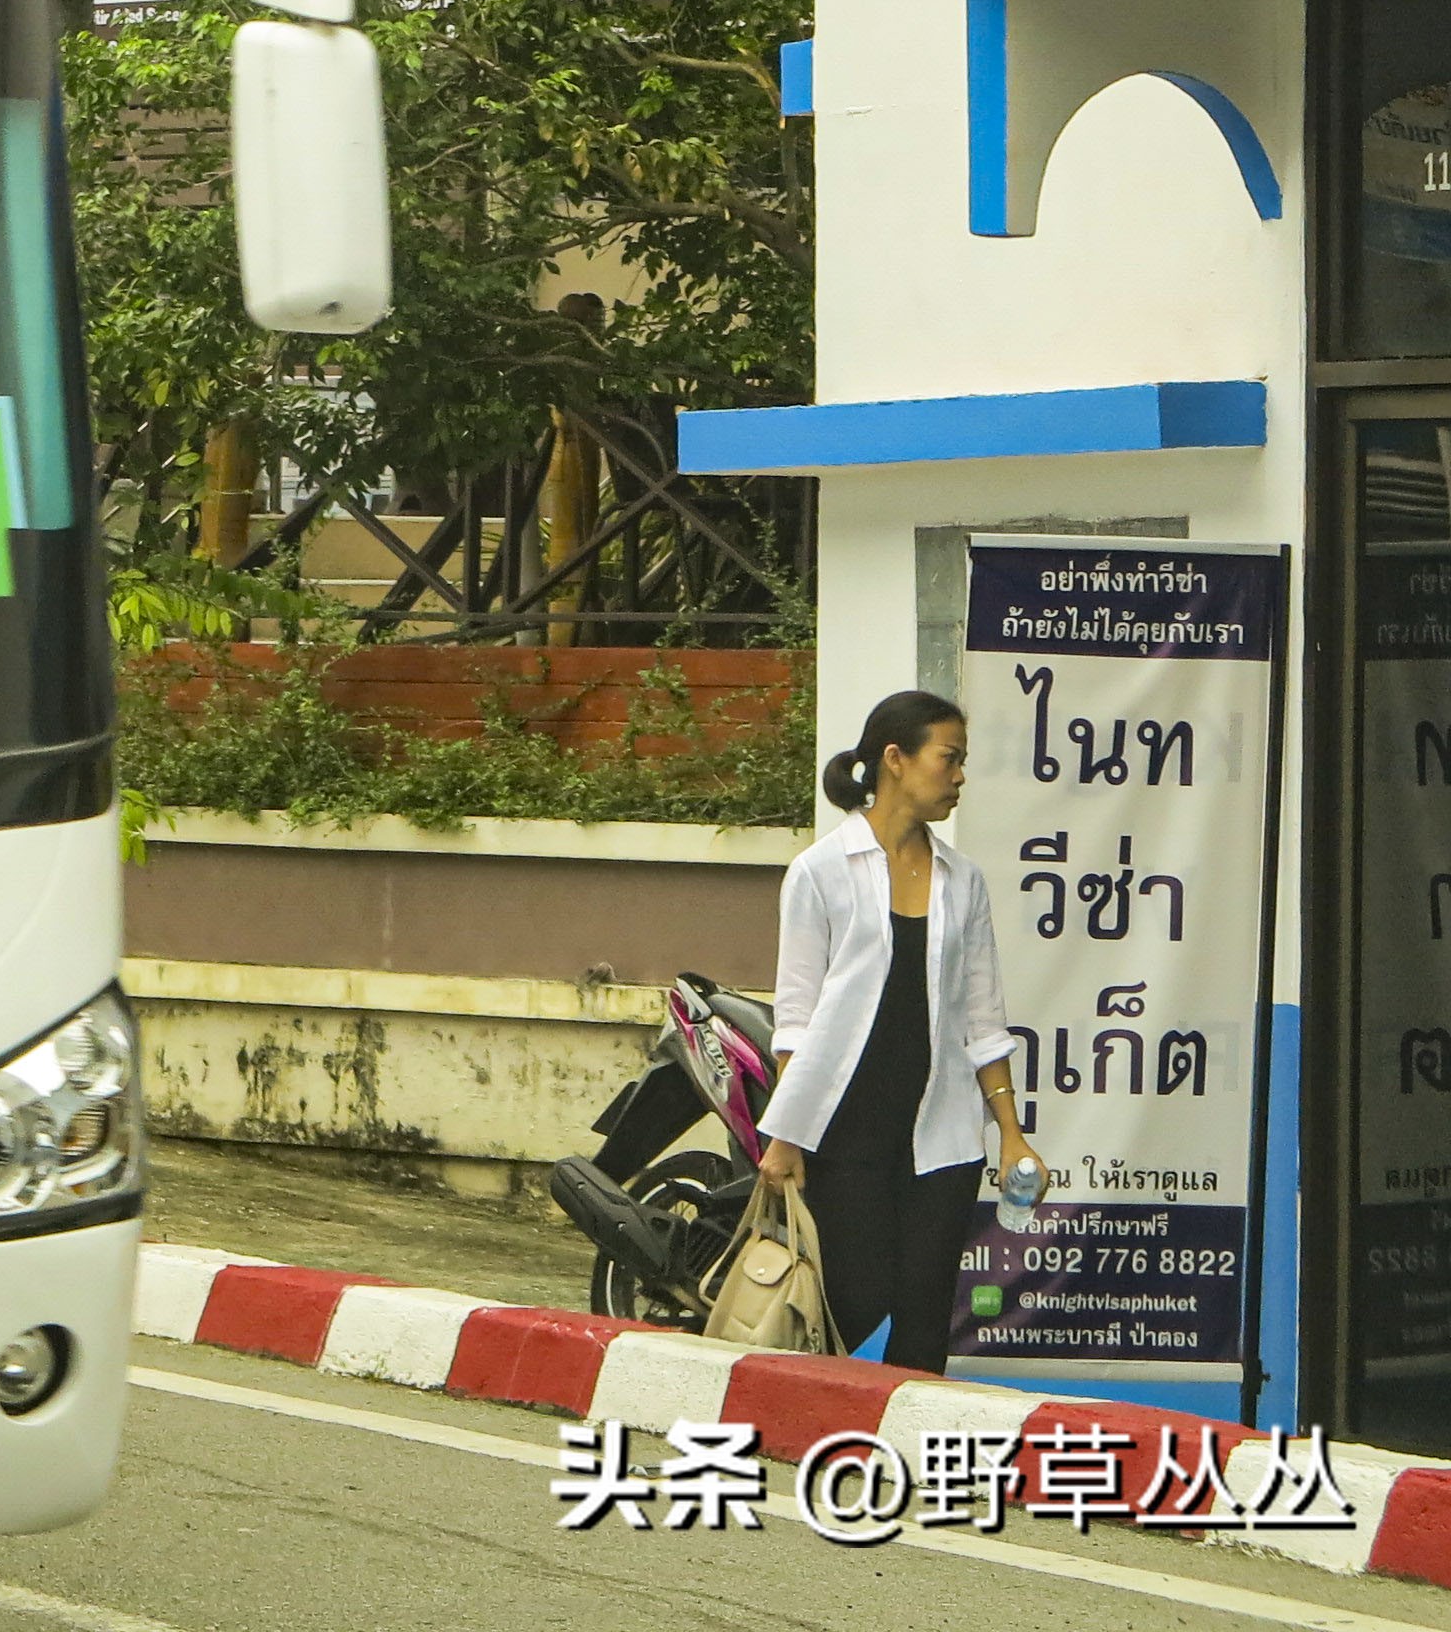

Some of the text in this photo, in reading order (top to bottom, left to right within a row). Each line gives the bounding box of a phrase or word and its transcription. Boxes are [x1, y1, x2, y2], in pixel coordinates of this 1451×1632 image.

[1040, 552, 1208, 594] อย่าพึ่งทำวีซ่า
[1001, 605, 1245, 655] ถ้ายังไม่ได้คุยกับเรา
[1015, 663, 1195, 786] ไนท
[1019, 831, 1185, 941] วีซ่า
[1081, 1155, 1218, 1202] ให้เราดูแล
[959, 1246, 990, 1271] all
[1023, 1246, 1084, 1274] 092
[1096, 1247, 1148, 1275] 776
[1158, 1248, 1237, 1277] 8822
[977, 1322, 1199, 1348] ถนนพระบารมี ป่าตอง
